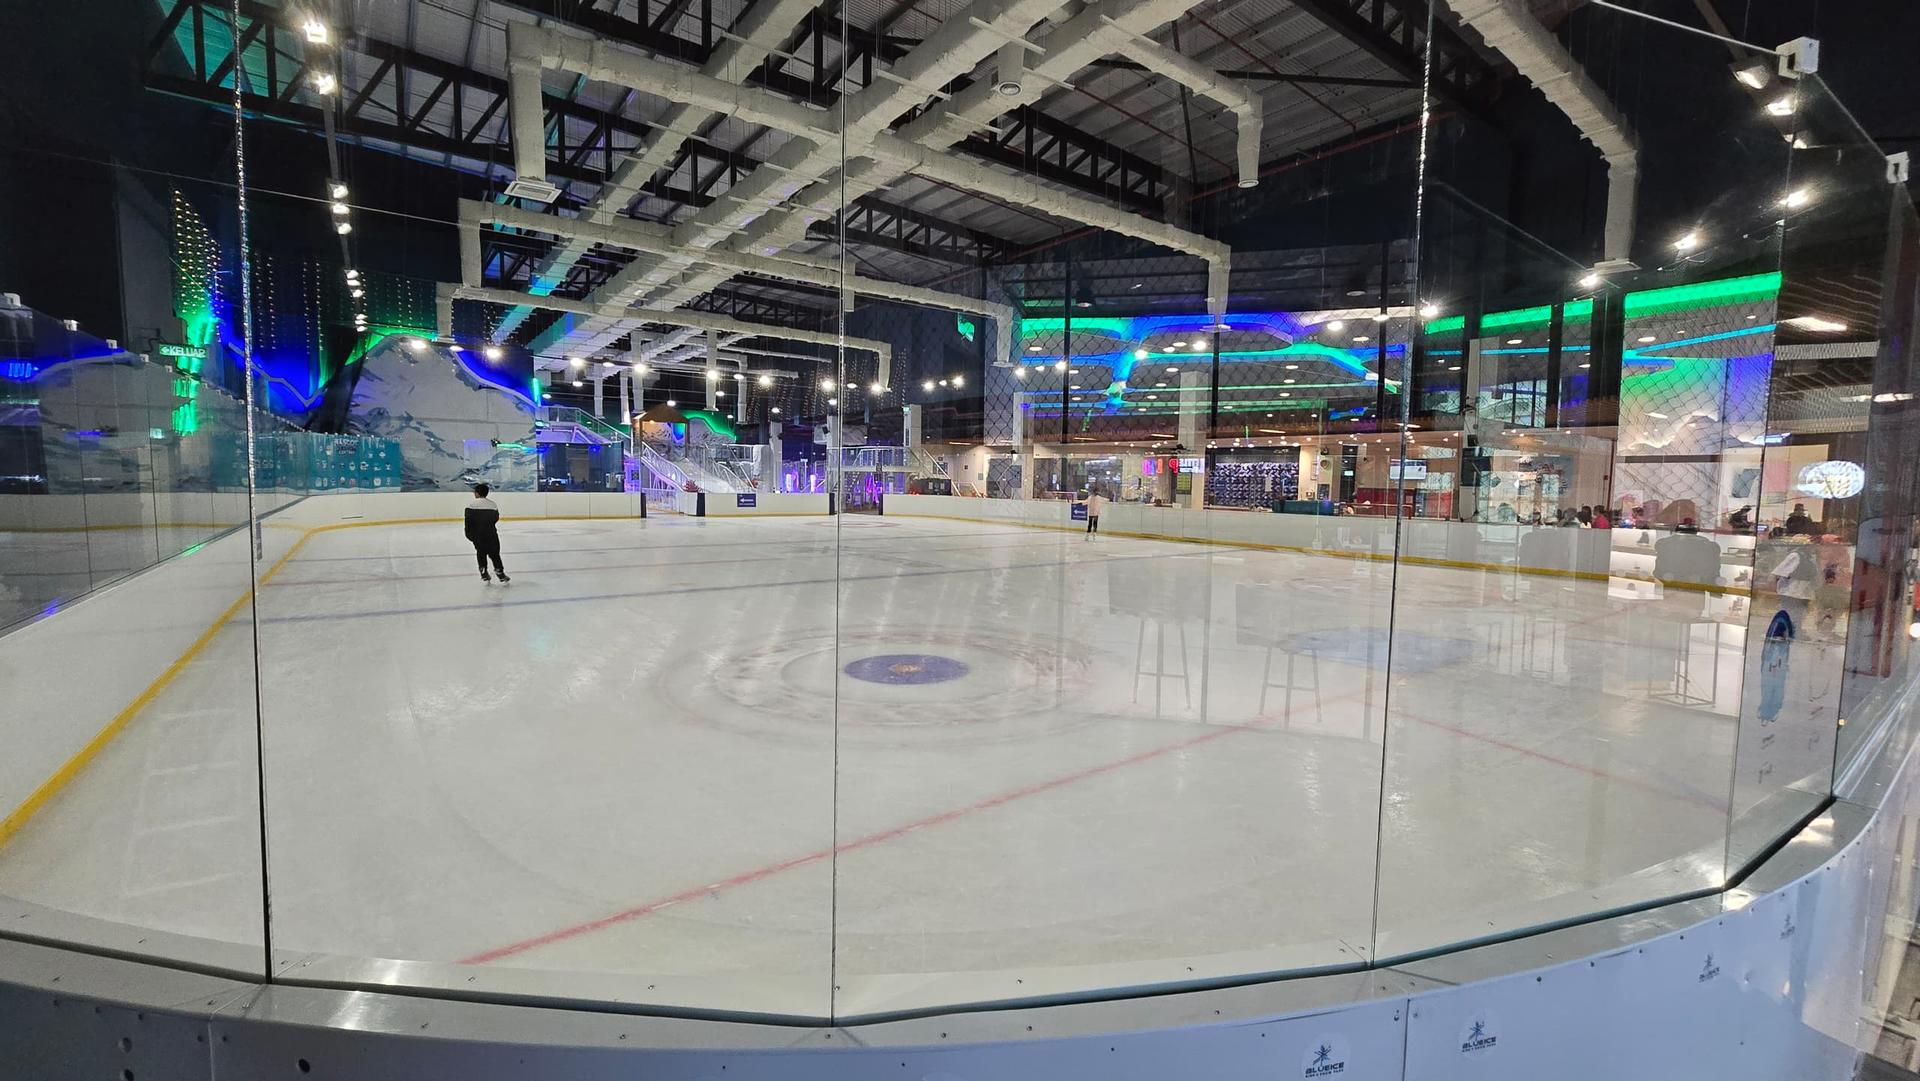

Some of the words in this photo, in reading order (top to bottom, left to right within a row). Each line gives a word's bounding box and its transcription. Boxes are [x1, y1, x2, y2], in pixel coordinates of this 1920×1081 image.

[169, 346, 206, 358] KELUAR
[1462, 1036, 1496, 1049] BLUEICE
[1305, 1061, 1344, 1075] BLUEICE
